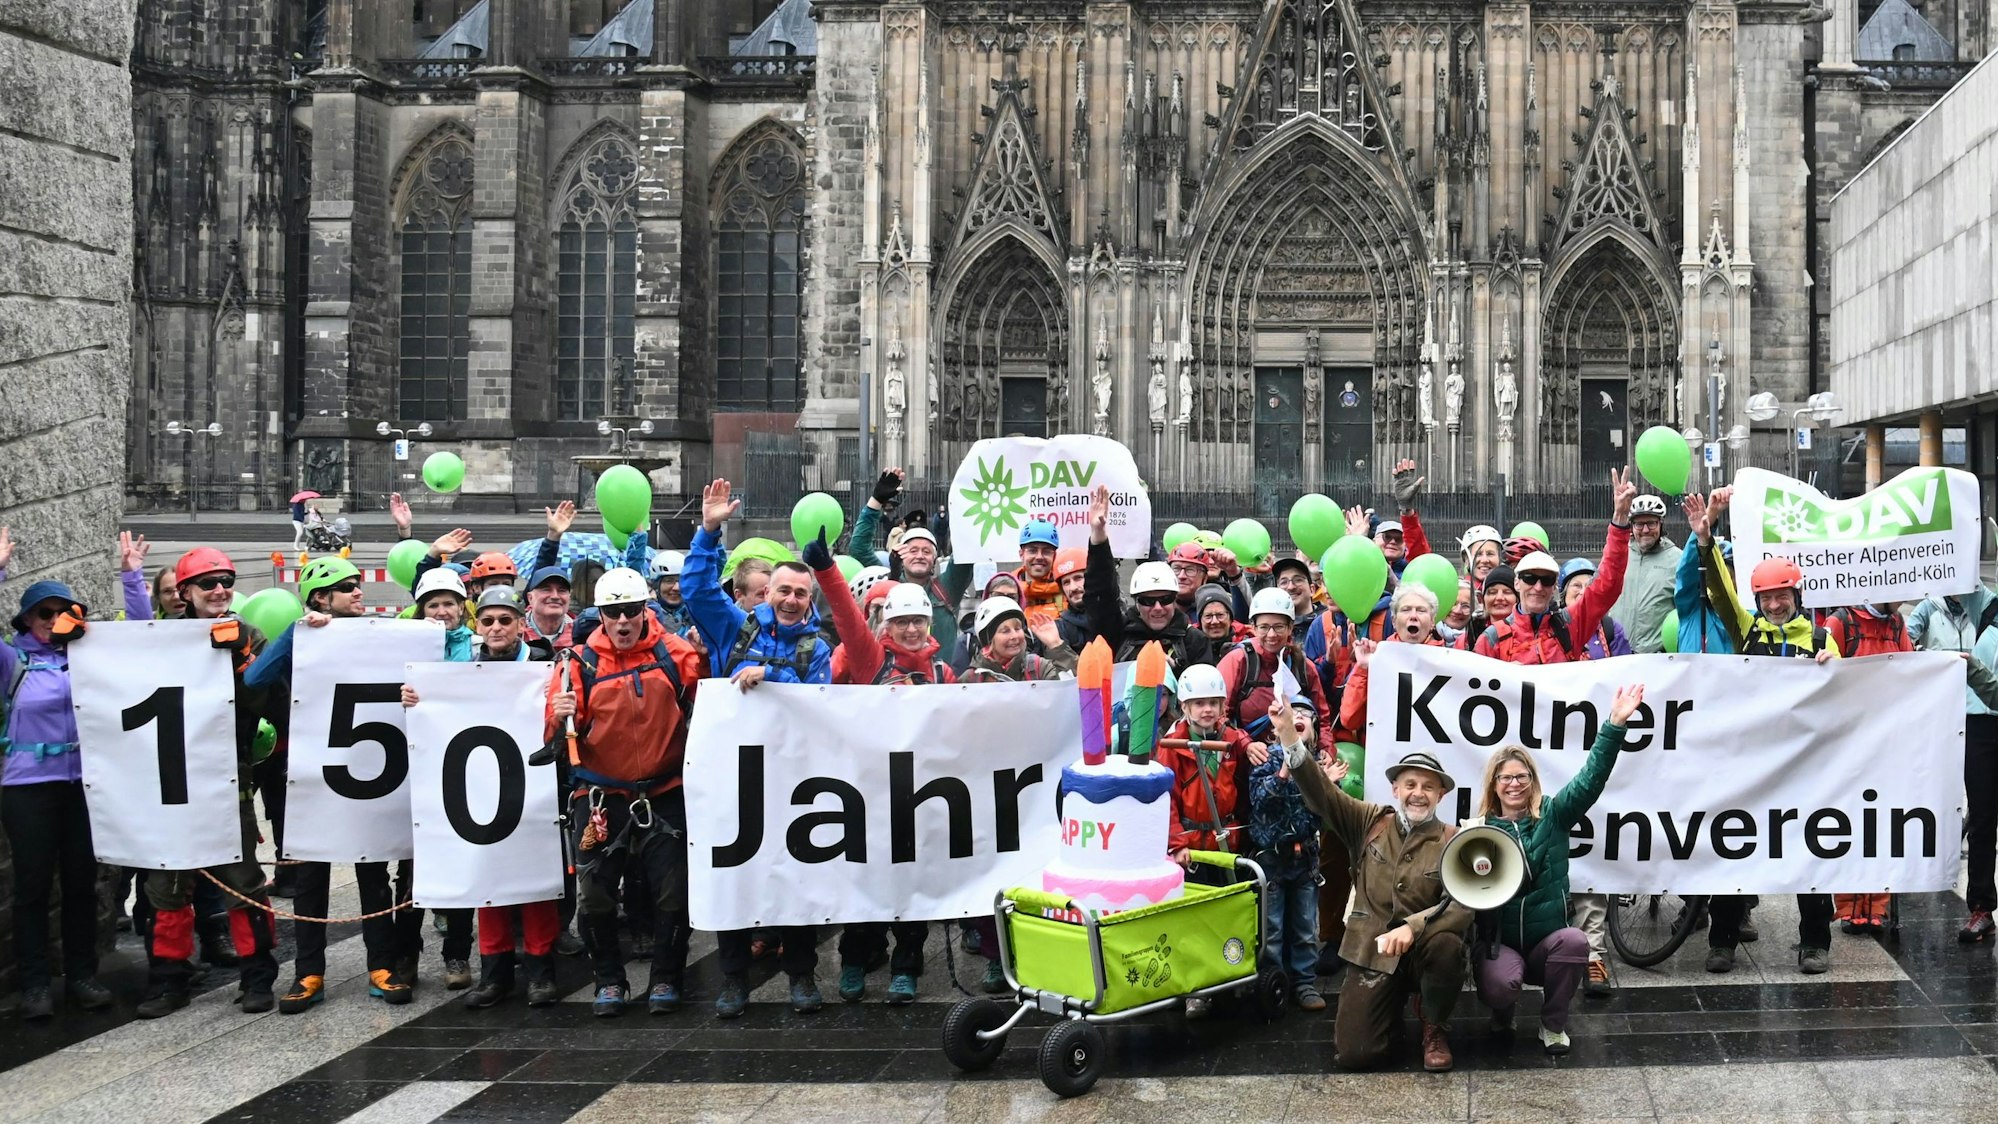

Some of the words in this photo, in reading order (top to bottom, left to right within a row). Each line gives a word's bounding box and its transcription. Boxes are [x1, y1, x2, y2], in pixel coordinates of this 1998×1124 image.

[1030, 460, 1097, 489] DAV
[1030, 491, 1137, 508] RheinlanKöln
[1824, 478, 1939, 540] DAV
[1061, 511, 1090, 528] JAH
[1109, 511, 1127, 519] 1876
[1763, 549, 1854, 567] Dutscher
[1860, 539, 1955, 566] Alpenverein
[1836, 564, 1956, 589] Rheinland-Köln
[1396, 672, 1694, 752] Kölner
[712, 745, 1064, 868] Jahr
[1061, 816, 1116, 851] APPY
[1456, 787, 1936, 859] lenverein
